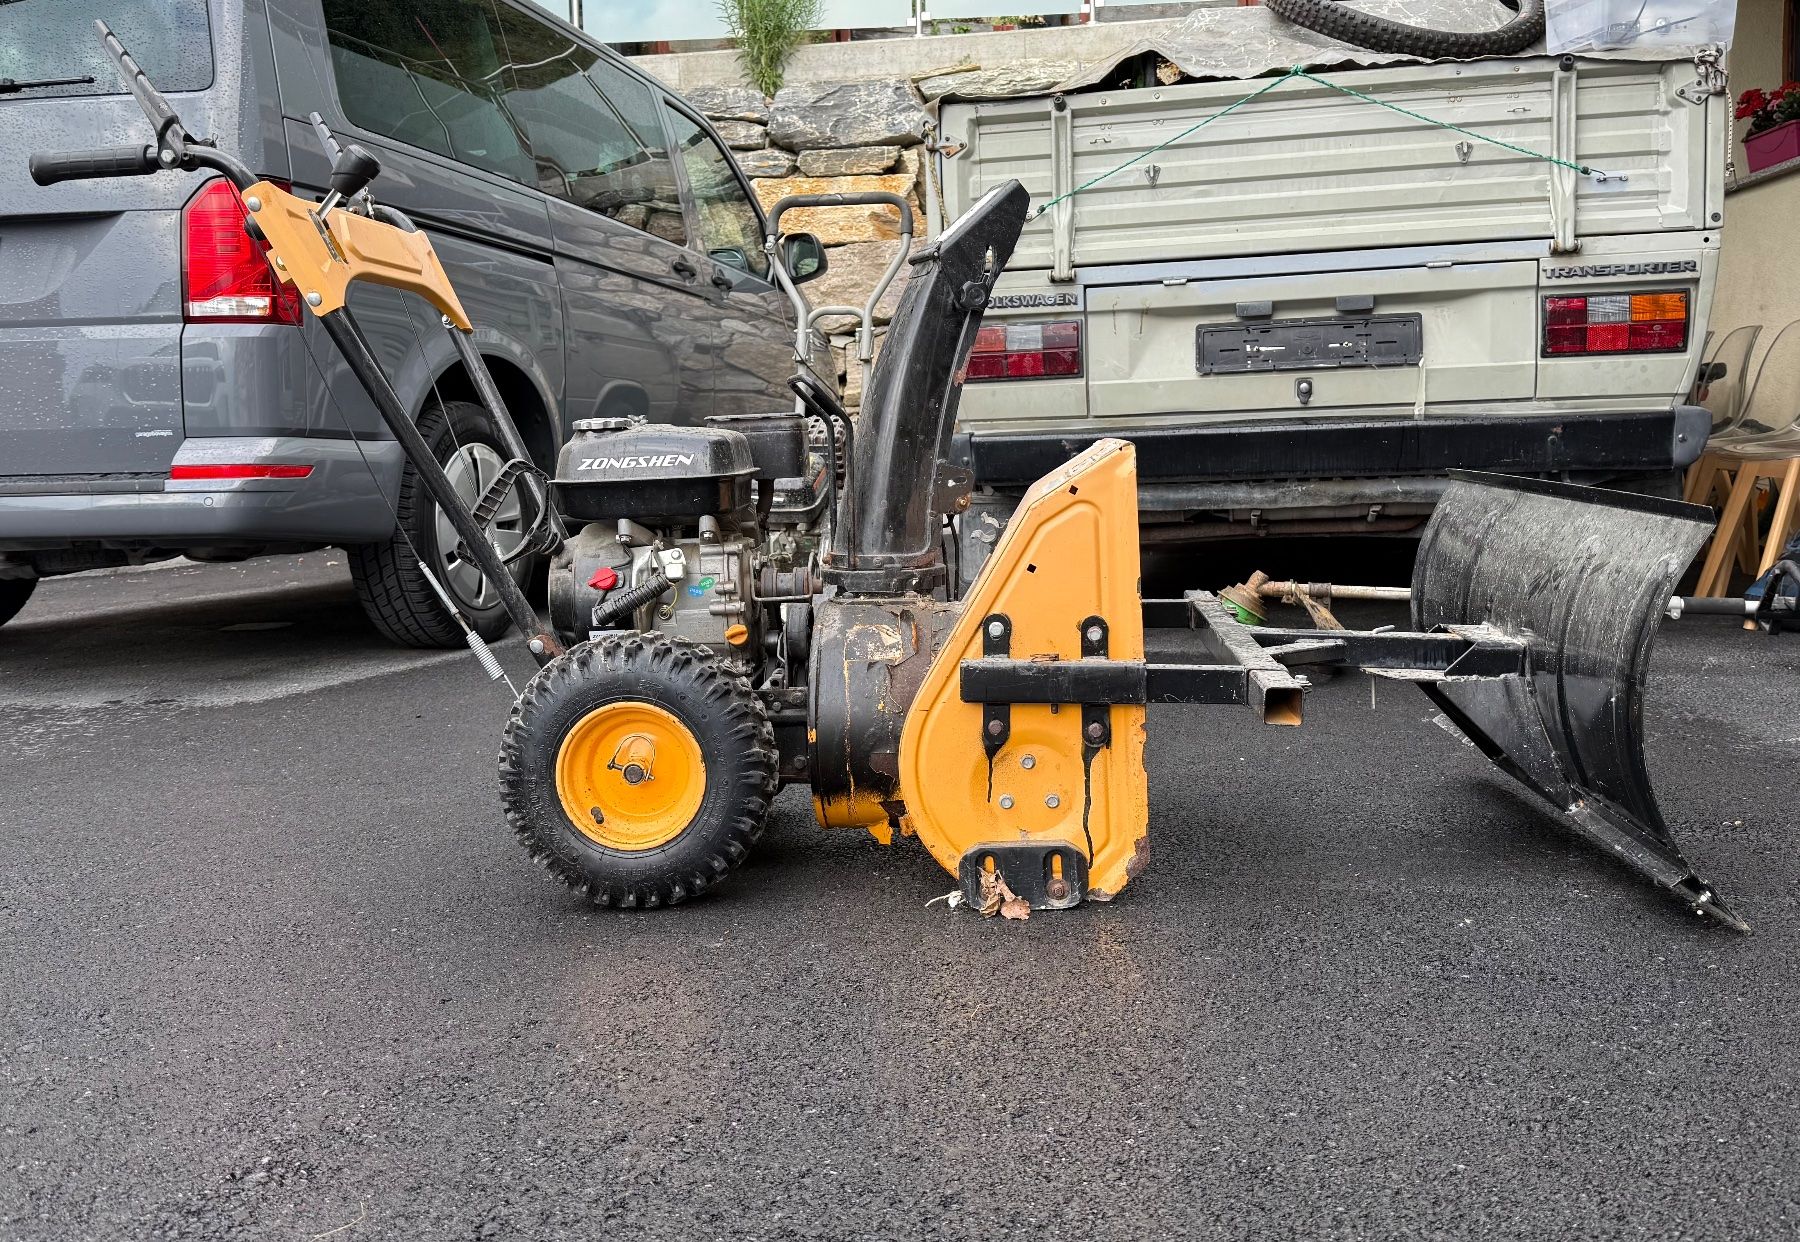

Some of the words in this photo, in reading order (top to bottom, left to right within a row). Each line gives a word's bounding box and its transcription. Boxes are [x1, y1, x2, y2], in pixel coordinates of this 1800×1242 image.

[1542, 259, 1698, 279] TRANSPORTER
[987, 293, 1078, 308] OLKSWAGEN
[577, 454, 695, 471] ZONGSHEN
